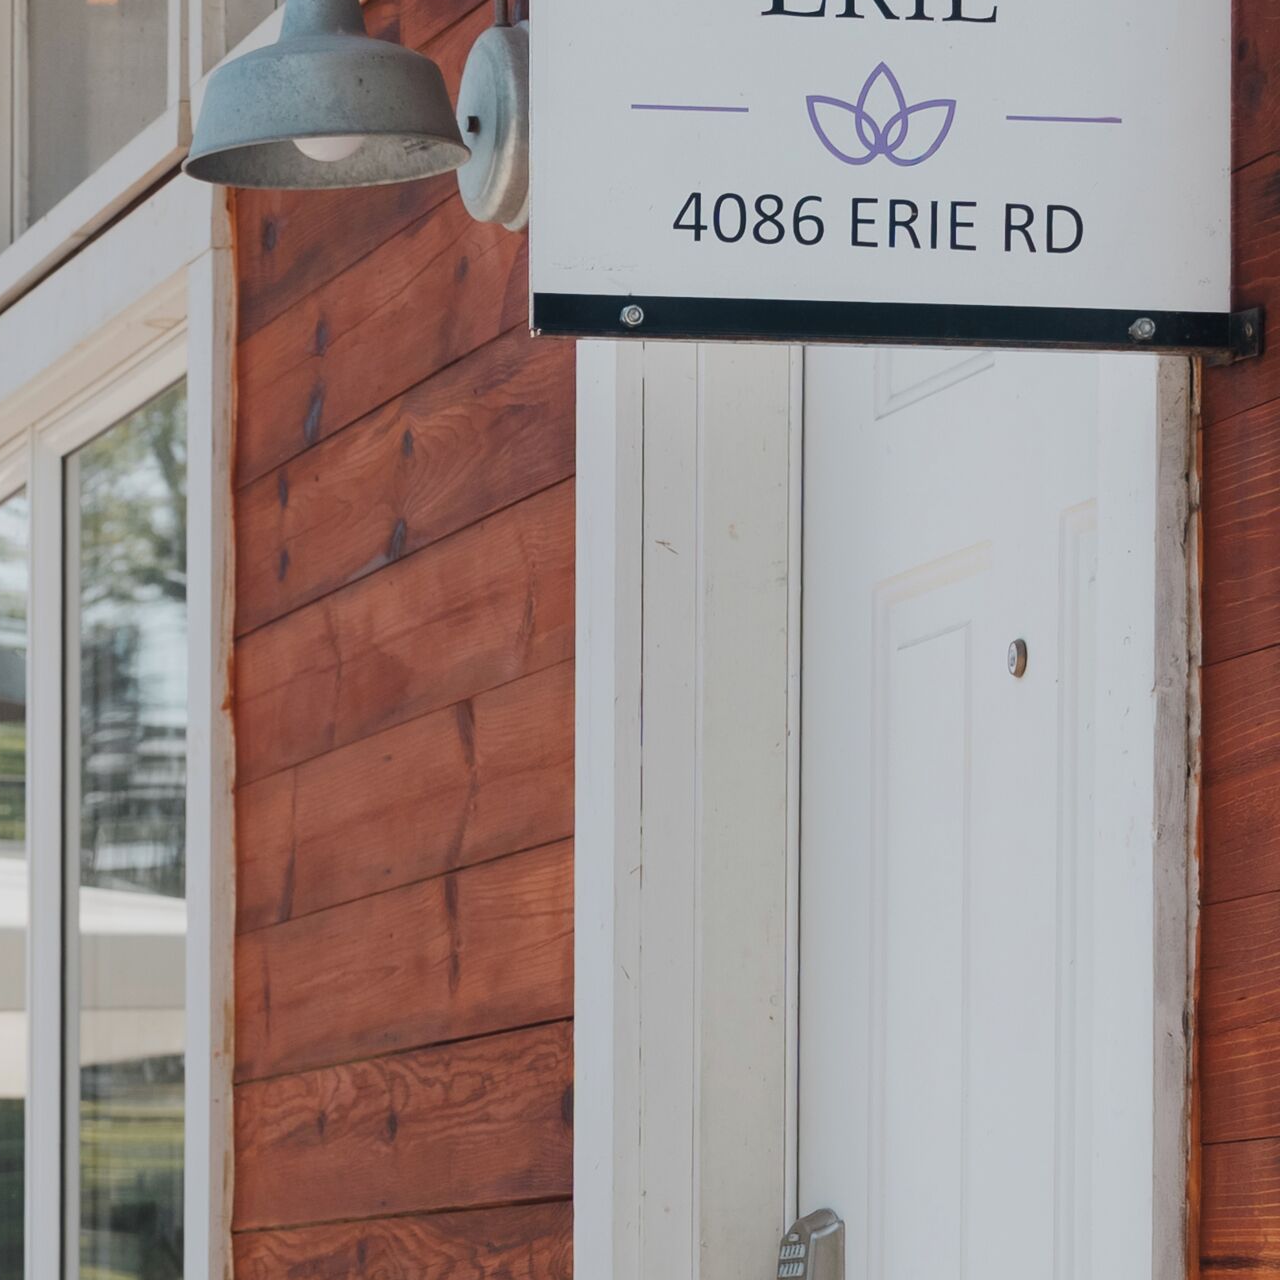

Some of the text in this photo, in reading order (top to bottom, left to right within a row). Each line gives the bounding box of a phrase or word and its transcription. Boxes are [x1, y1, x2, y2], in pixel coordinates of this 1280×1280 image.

[673, 192, 1084, 254] 4086 ERIE RD
